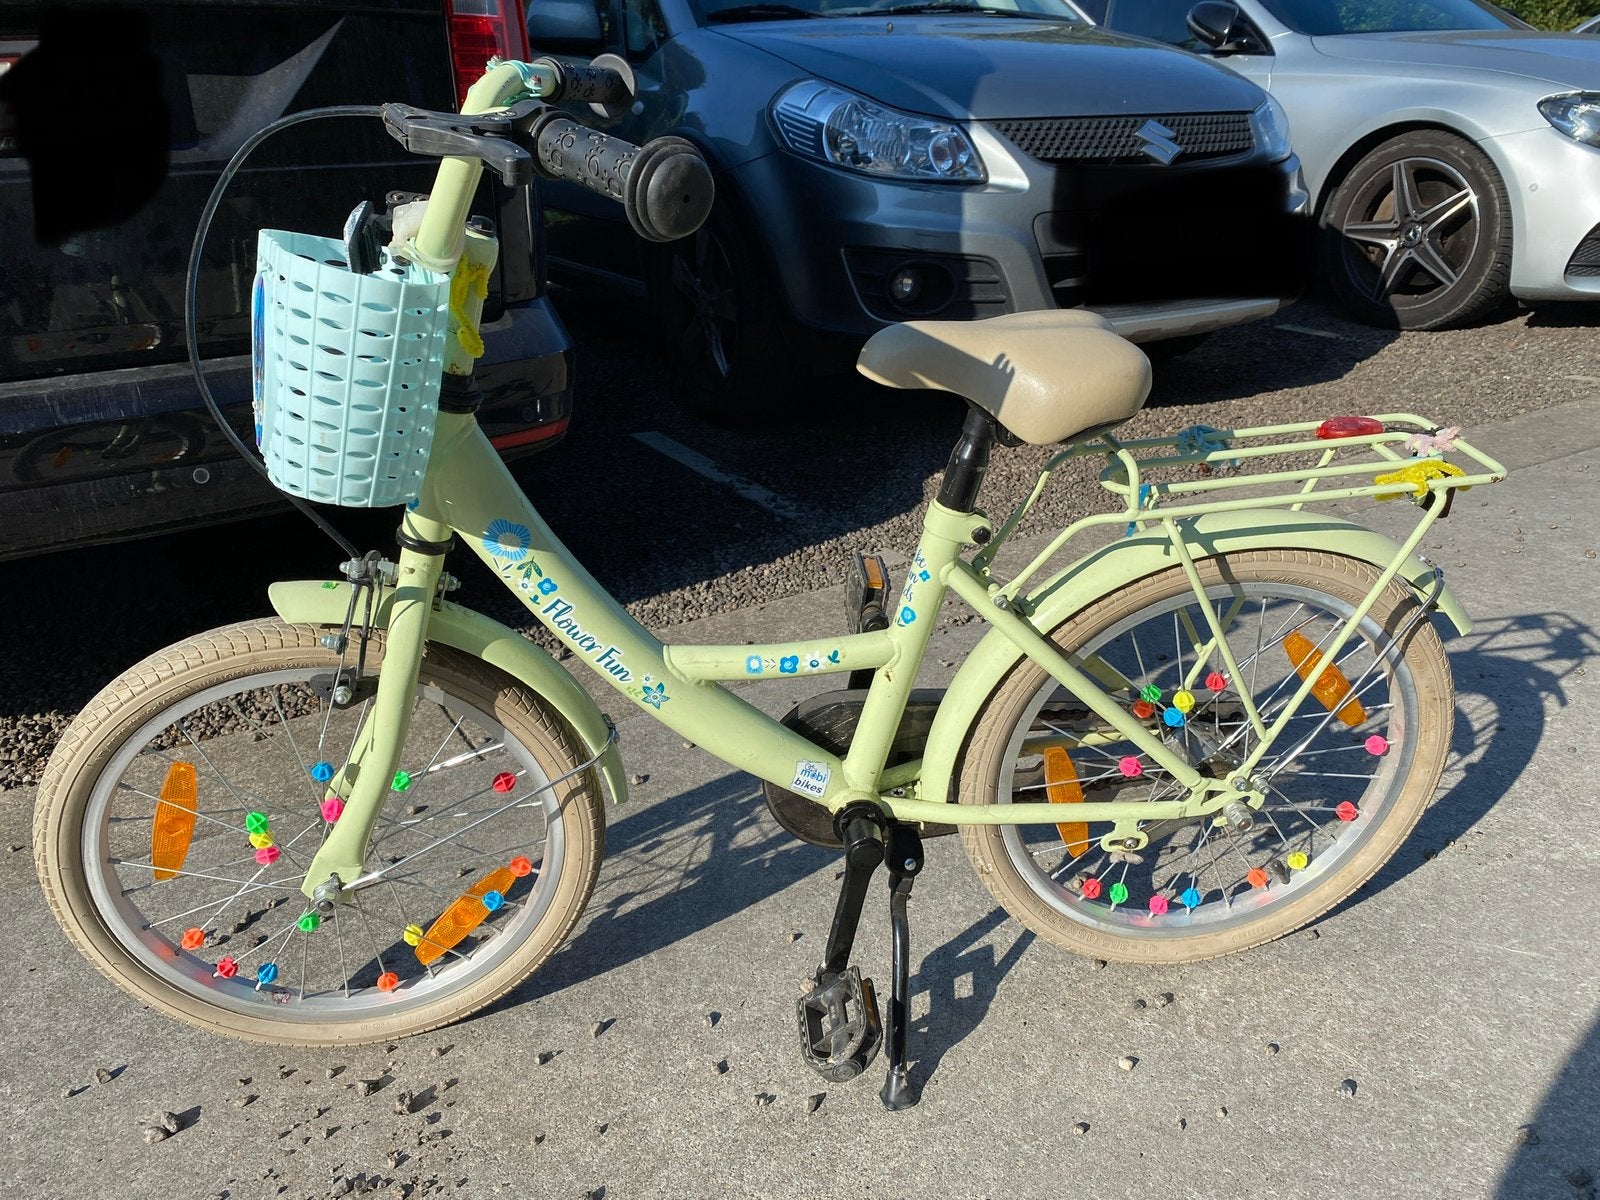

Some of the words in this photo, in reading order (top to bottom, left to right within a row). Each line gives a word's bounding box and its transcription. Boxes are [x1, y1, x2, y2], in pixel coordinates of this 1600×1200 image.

[541, 597, 602, 652] Flower
[595, 646, 632, 683] Fun
[793, 777, 823, 794] bikes
